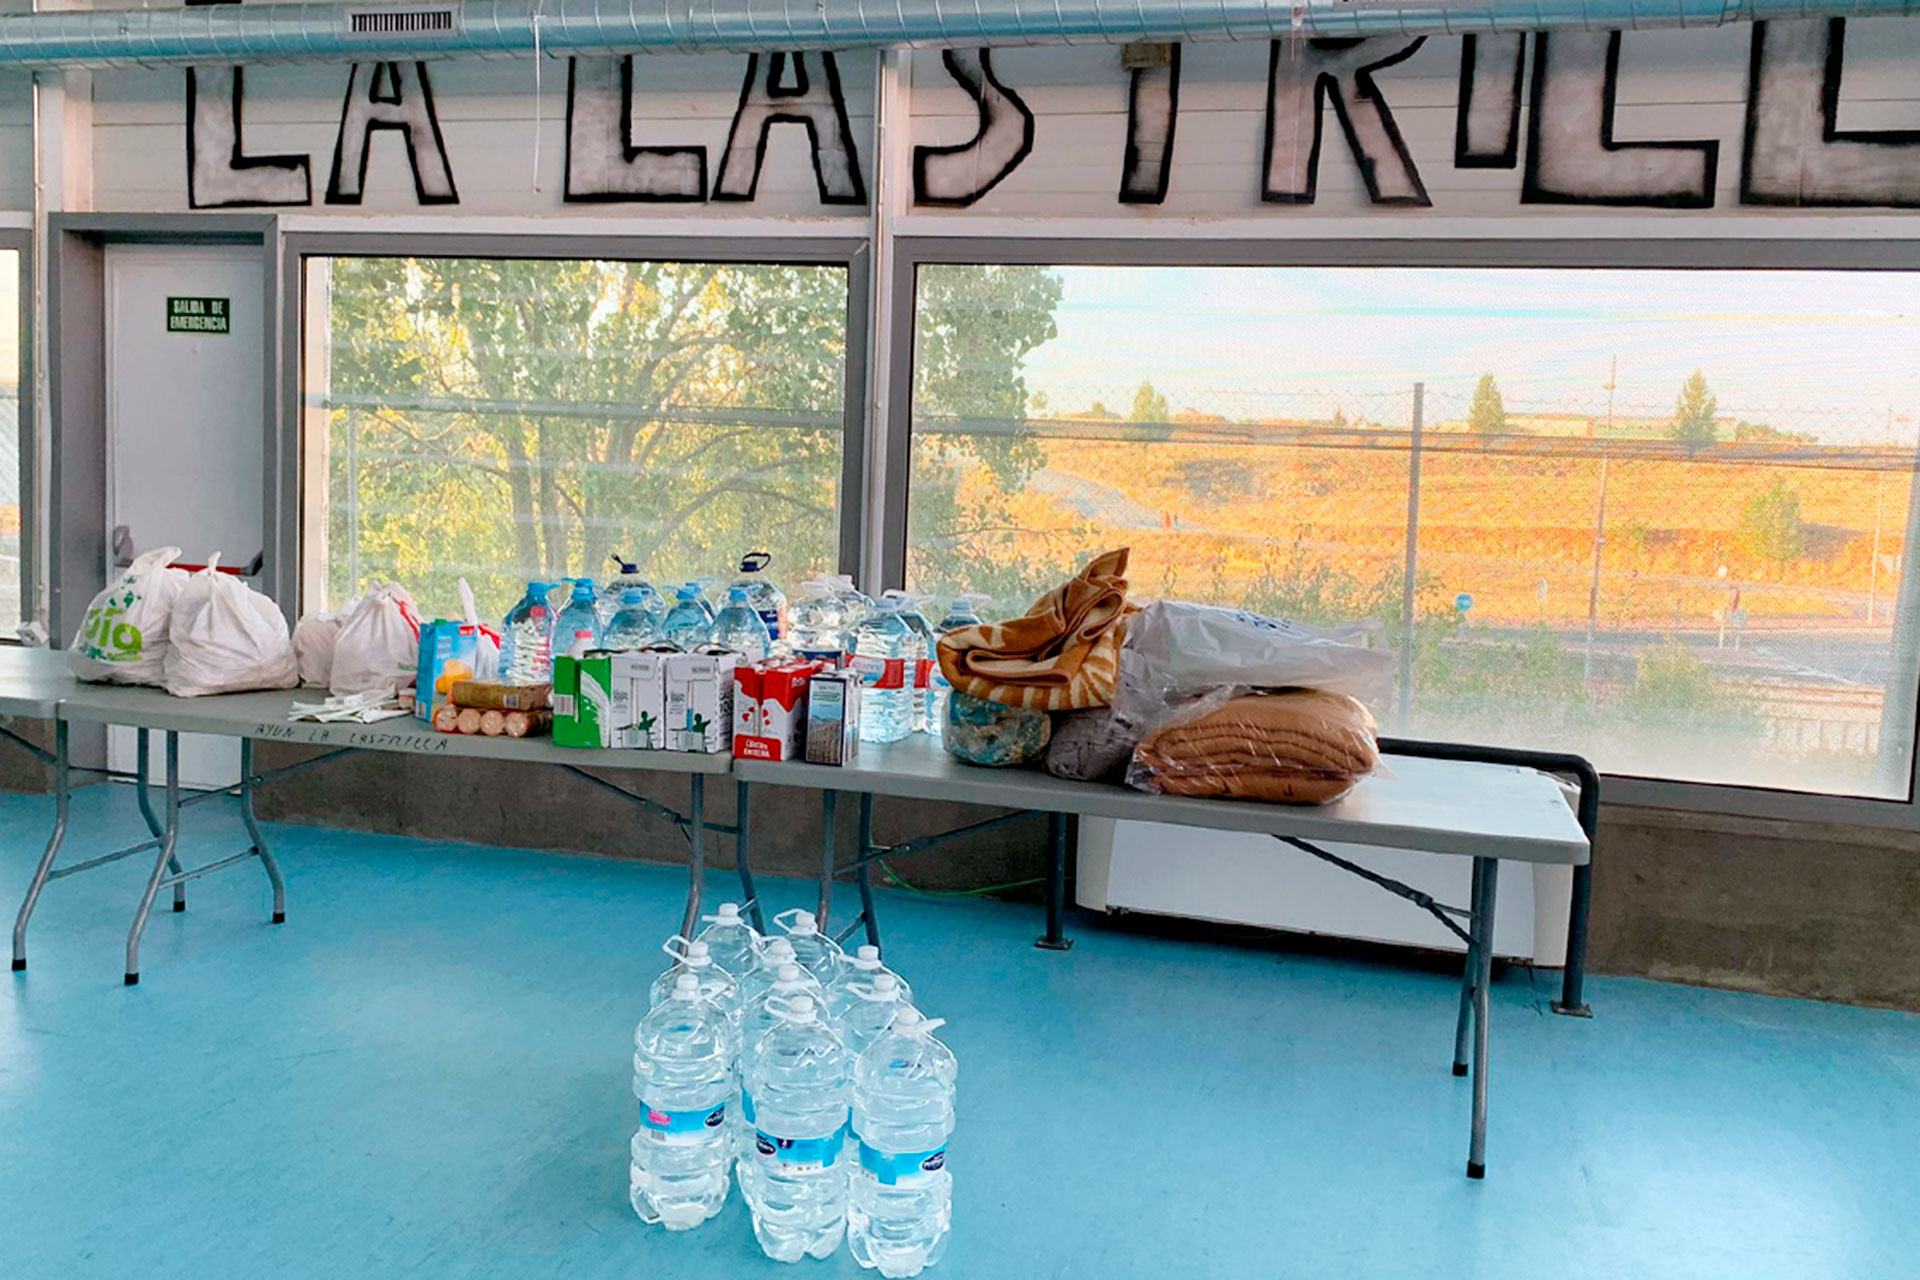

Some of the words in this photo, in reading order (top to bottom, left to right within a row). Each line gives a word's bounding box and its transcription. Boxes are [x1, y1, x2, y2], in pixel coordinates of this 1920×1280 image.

[186, 58, 458, 208] LA
[173, 299, 205, 314] SALIDA
[211, 300, 224, 315] DE
[170, 315, 227, 331] EMERGENCIA
[308, 729, 331, 742] LA
